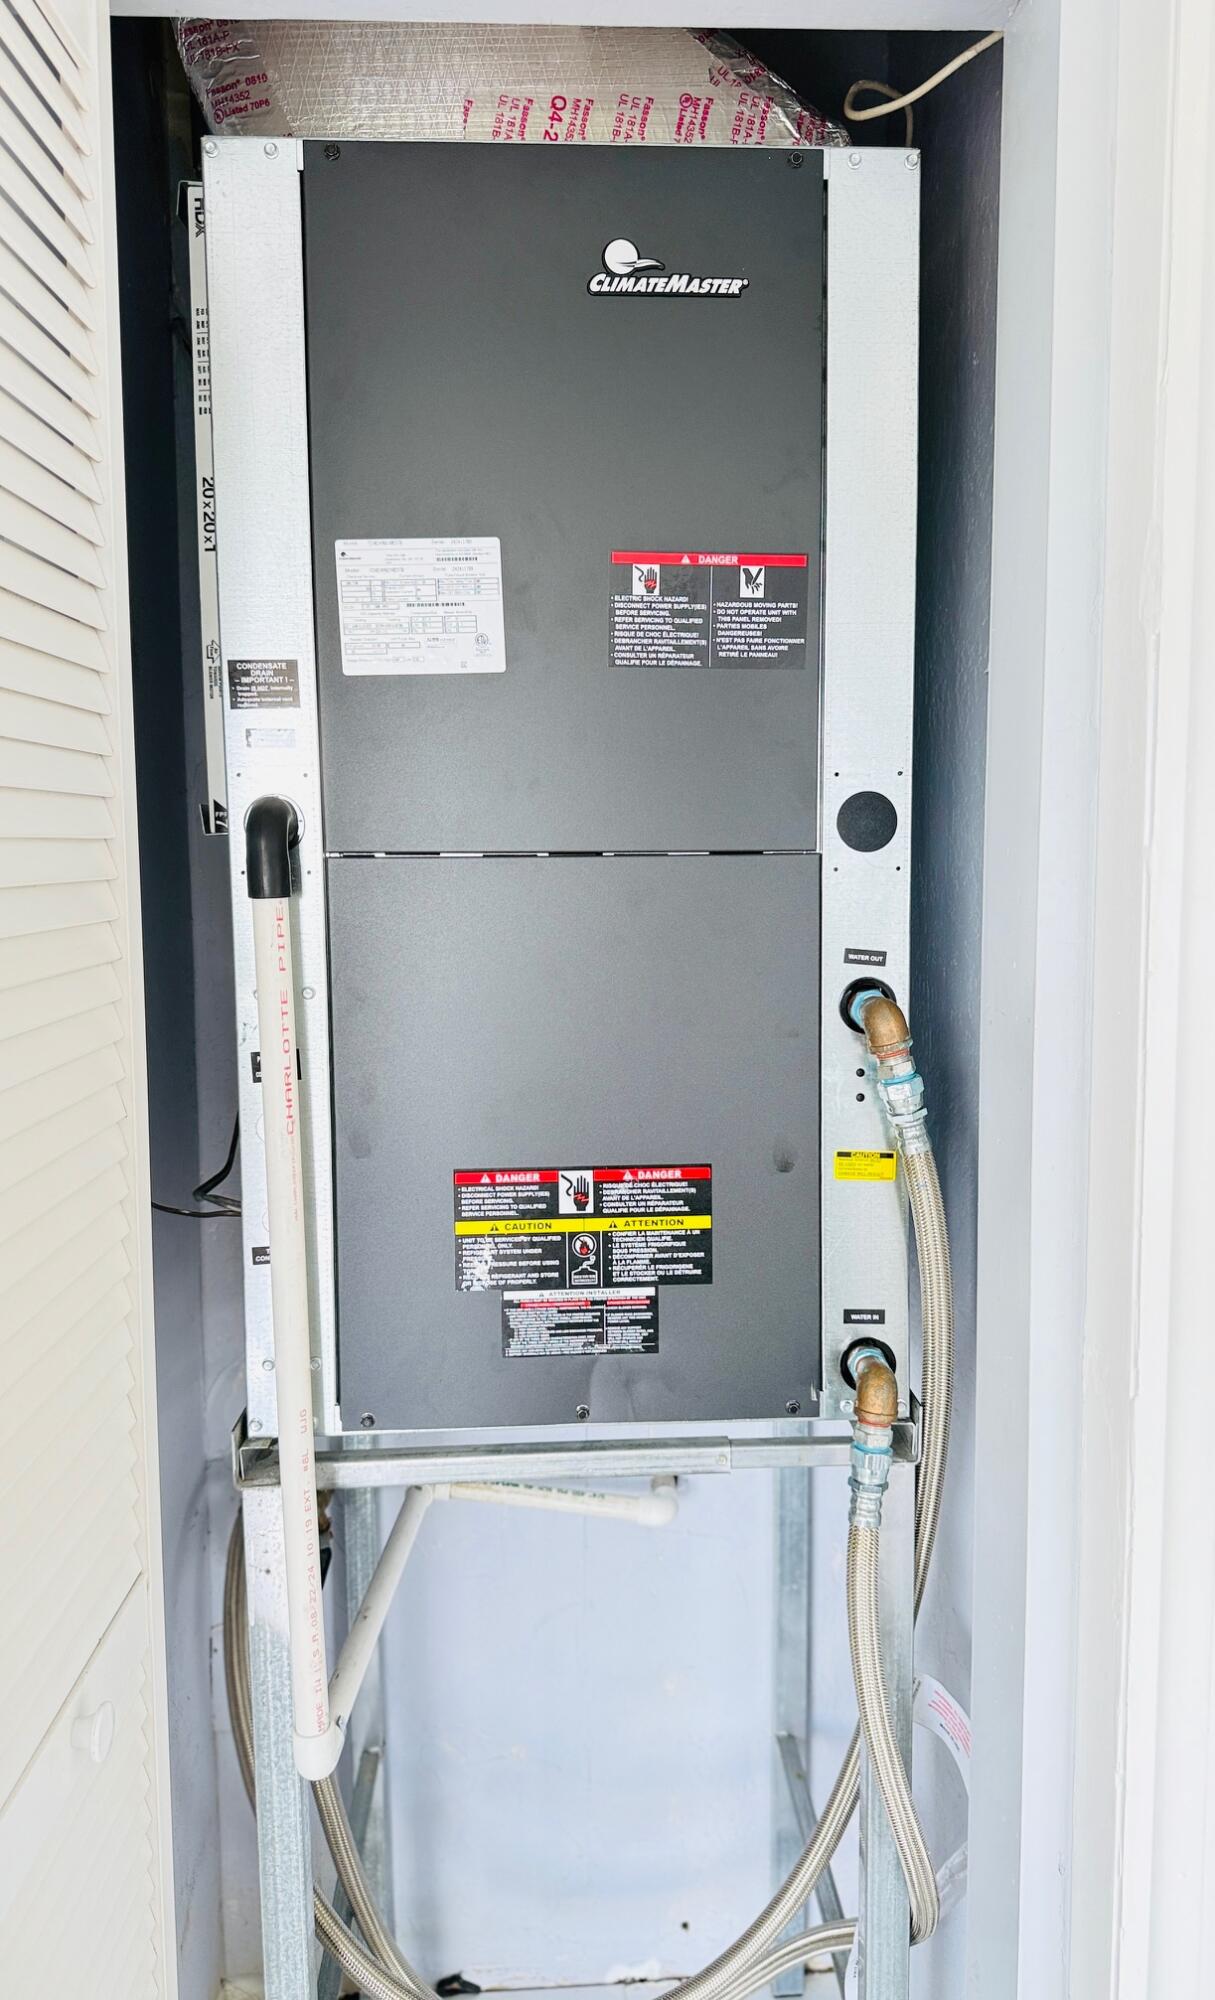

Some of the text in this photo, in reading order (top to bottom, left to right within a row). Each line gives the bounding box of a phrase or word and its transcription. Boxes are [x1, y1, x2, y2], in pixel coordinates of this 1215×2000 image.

[698, 555, 739, 565] DANGER
[236, 662, 289, 670] CONDENSATE
[240, 676, 284, 684] IMPORTANT
[848, 953, 870, 961] WATER
[275, 905, 296, 1136] CHARLOTTE PIPE
[495, 1173, 540, 1183] DANGER
[637, 1170, 682, 1180] DANGER
[504, 1222, 552, 1231] CAUTION
[623, 1219, 684, 1227] ATTENTION
[850, 1313, 879, 1321] WATER IN
